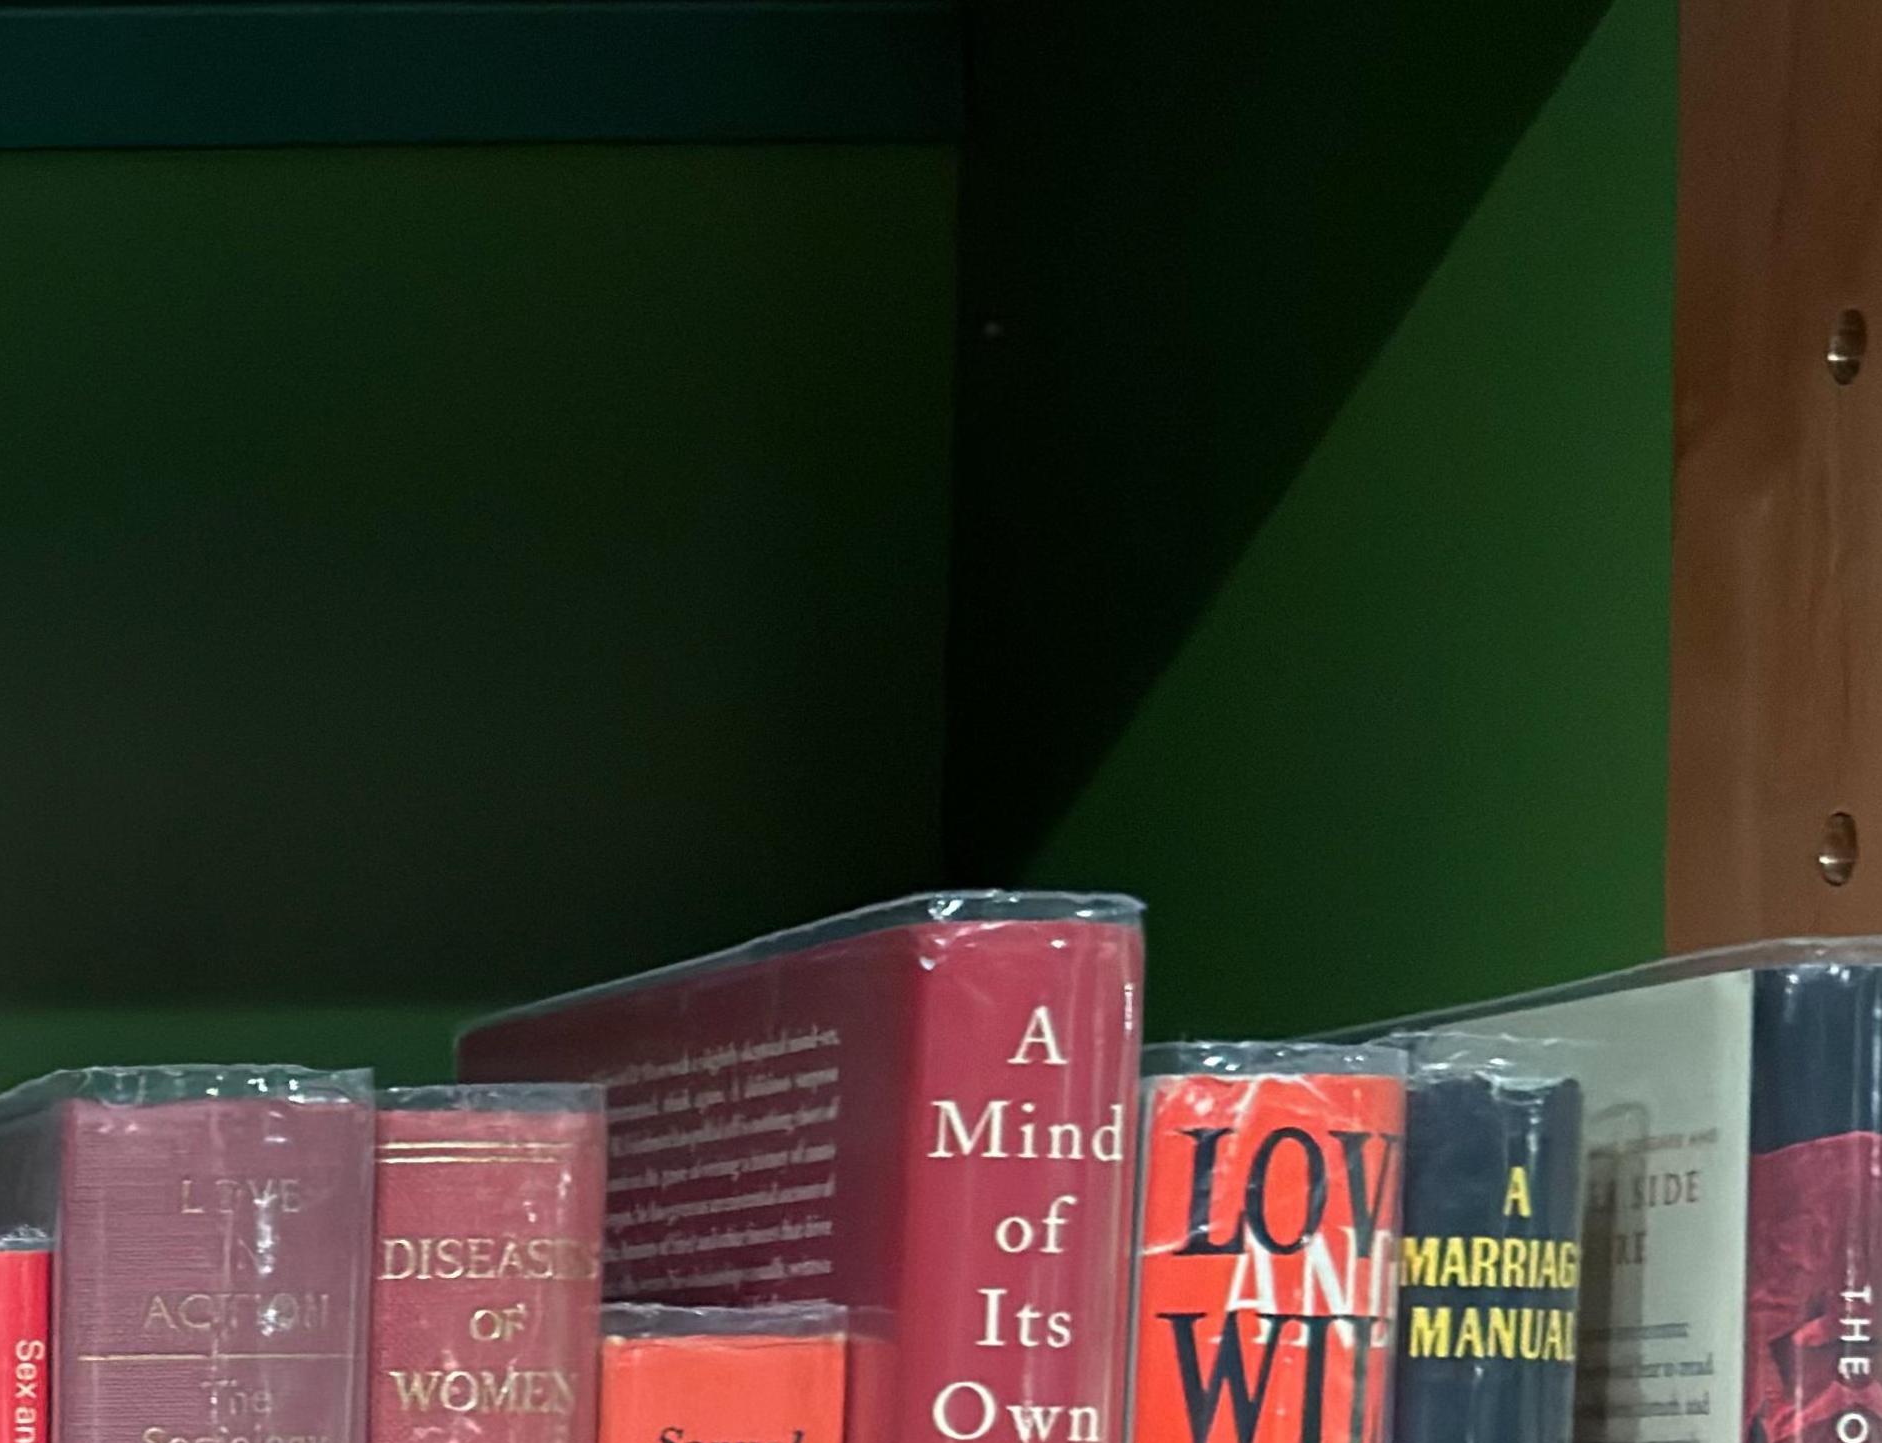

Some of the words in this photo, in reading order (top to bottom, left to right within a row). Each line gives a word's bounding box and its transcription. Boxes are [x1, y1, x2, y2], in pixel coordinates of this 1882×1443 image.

[1008, 1005, 1068, 1064] A
[928, 1101, 1124, 1162] Mind
[995, 1196, 1077, 1254] of
[976, 1288, 1073, 1348] Its
[1838, 1288, 1871, 1381] THE
[14, 1339, 44, 1397] Sex
[934, 1382, 1103, 1442] Own
